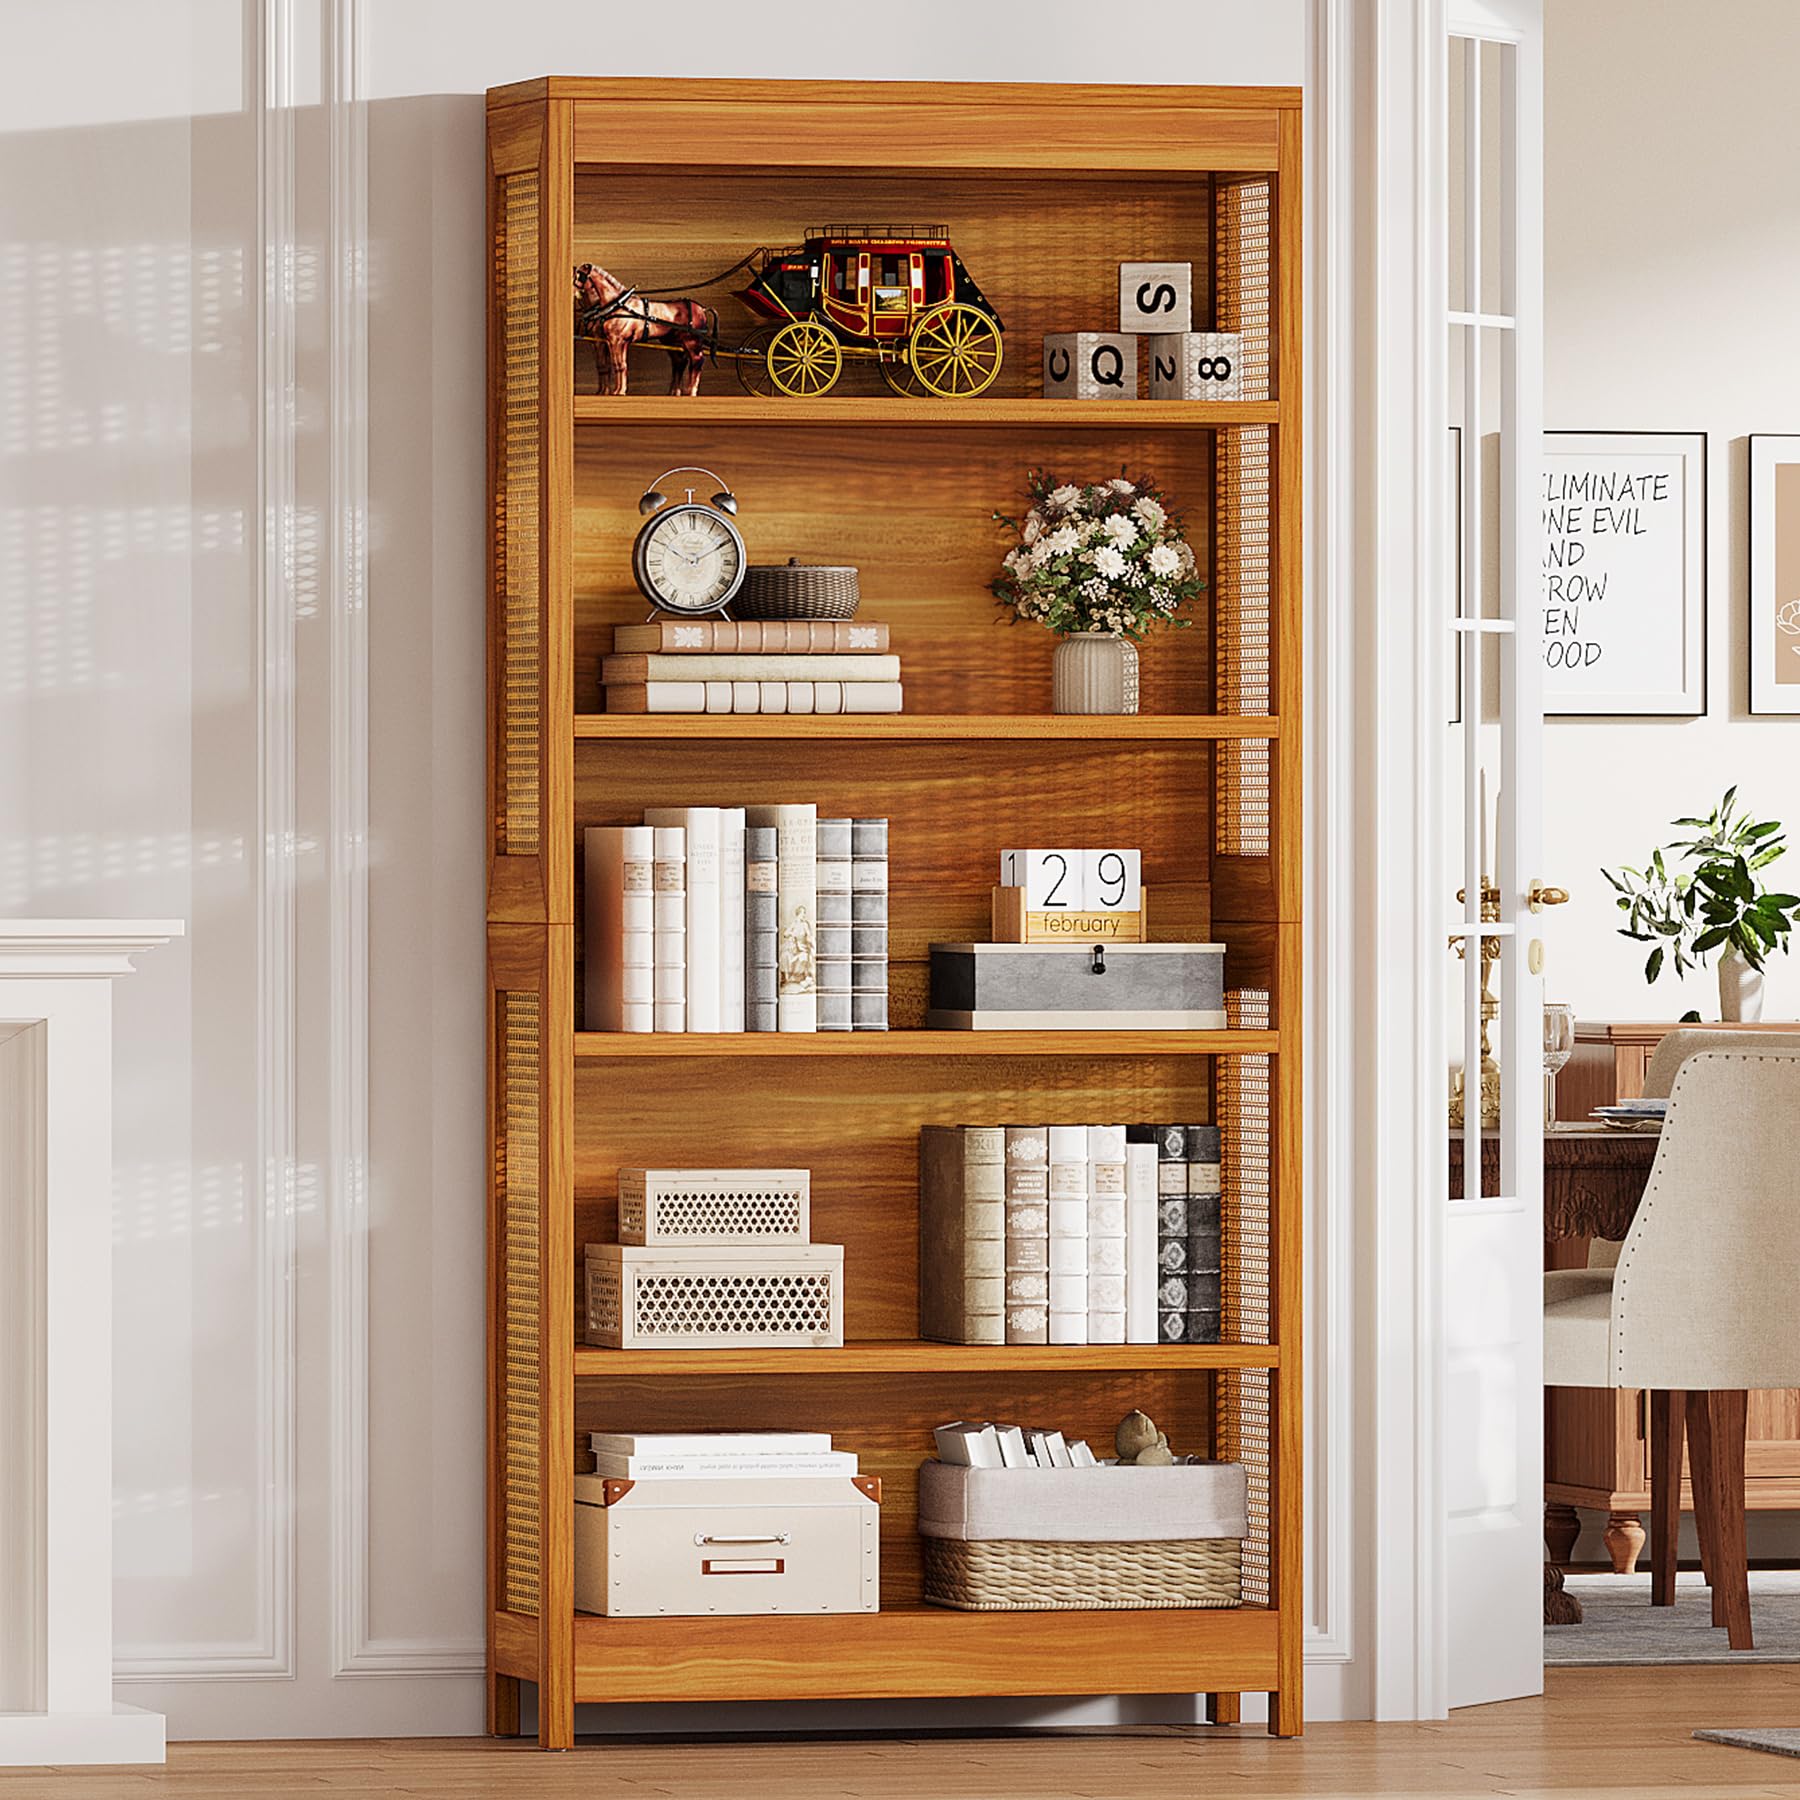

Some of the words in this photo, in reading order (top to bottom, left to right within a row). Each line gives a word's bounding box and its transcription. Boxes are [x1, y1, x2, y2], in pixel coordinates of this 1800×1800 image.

[1136, 282, 1177, 314] S
[1091, 345, 1125, 388] Q
[1155, 355, 1176, 382] 2
[1198, 356, 1231, 381] 8
[1542, 472, 1669, 502] LIMINATE
[1542, 505, 1583, 535] NE
[1593, 506, 1647, 535] EVIL
[1542, 539, 1585, 568] ND
[1542, 572, 1607, 602] ROW
[1542, 606, 1579, 636] EN
[1542, 640, 1602, 668] OOD
[1044, 913, 1120, 936] february
